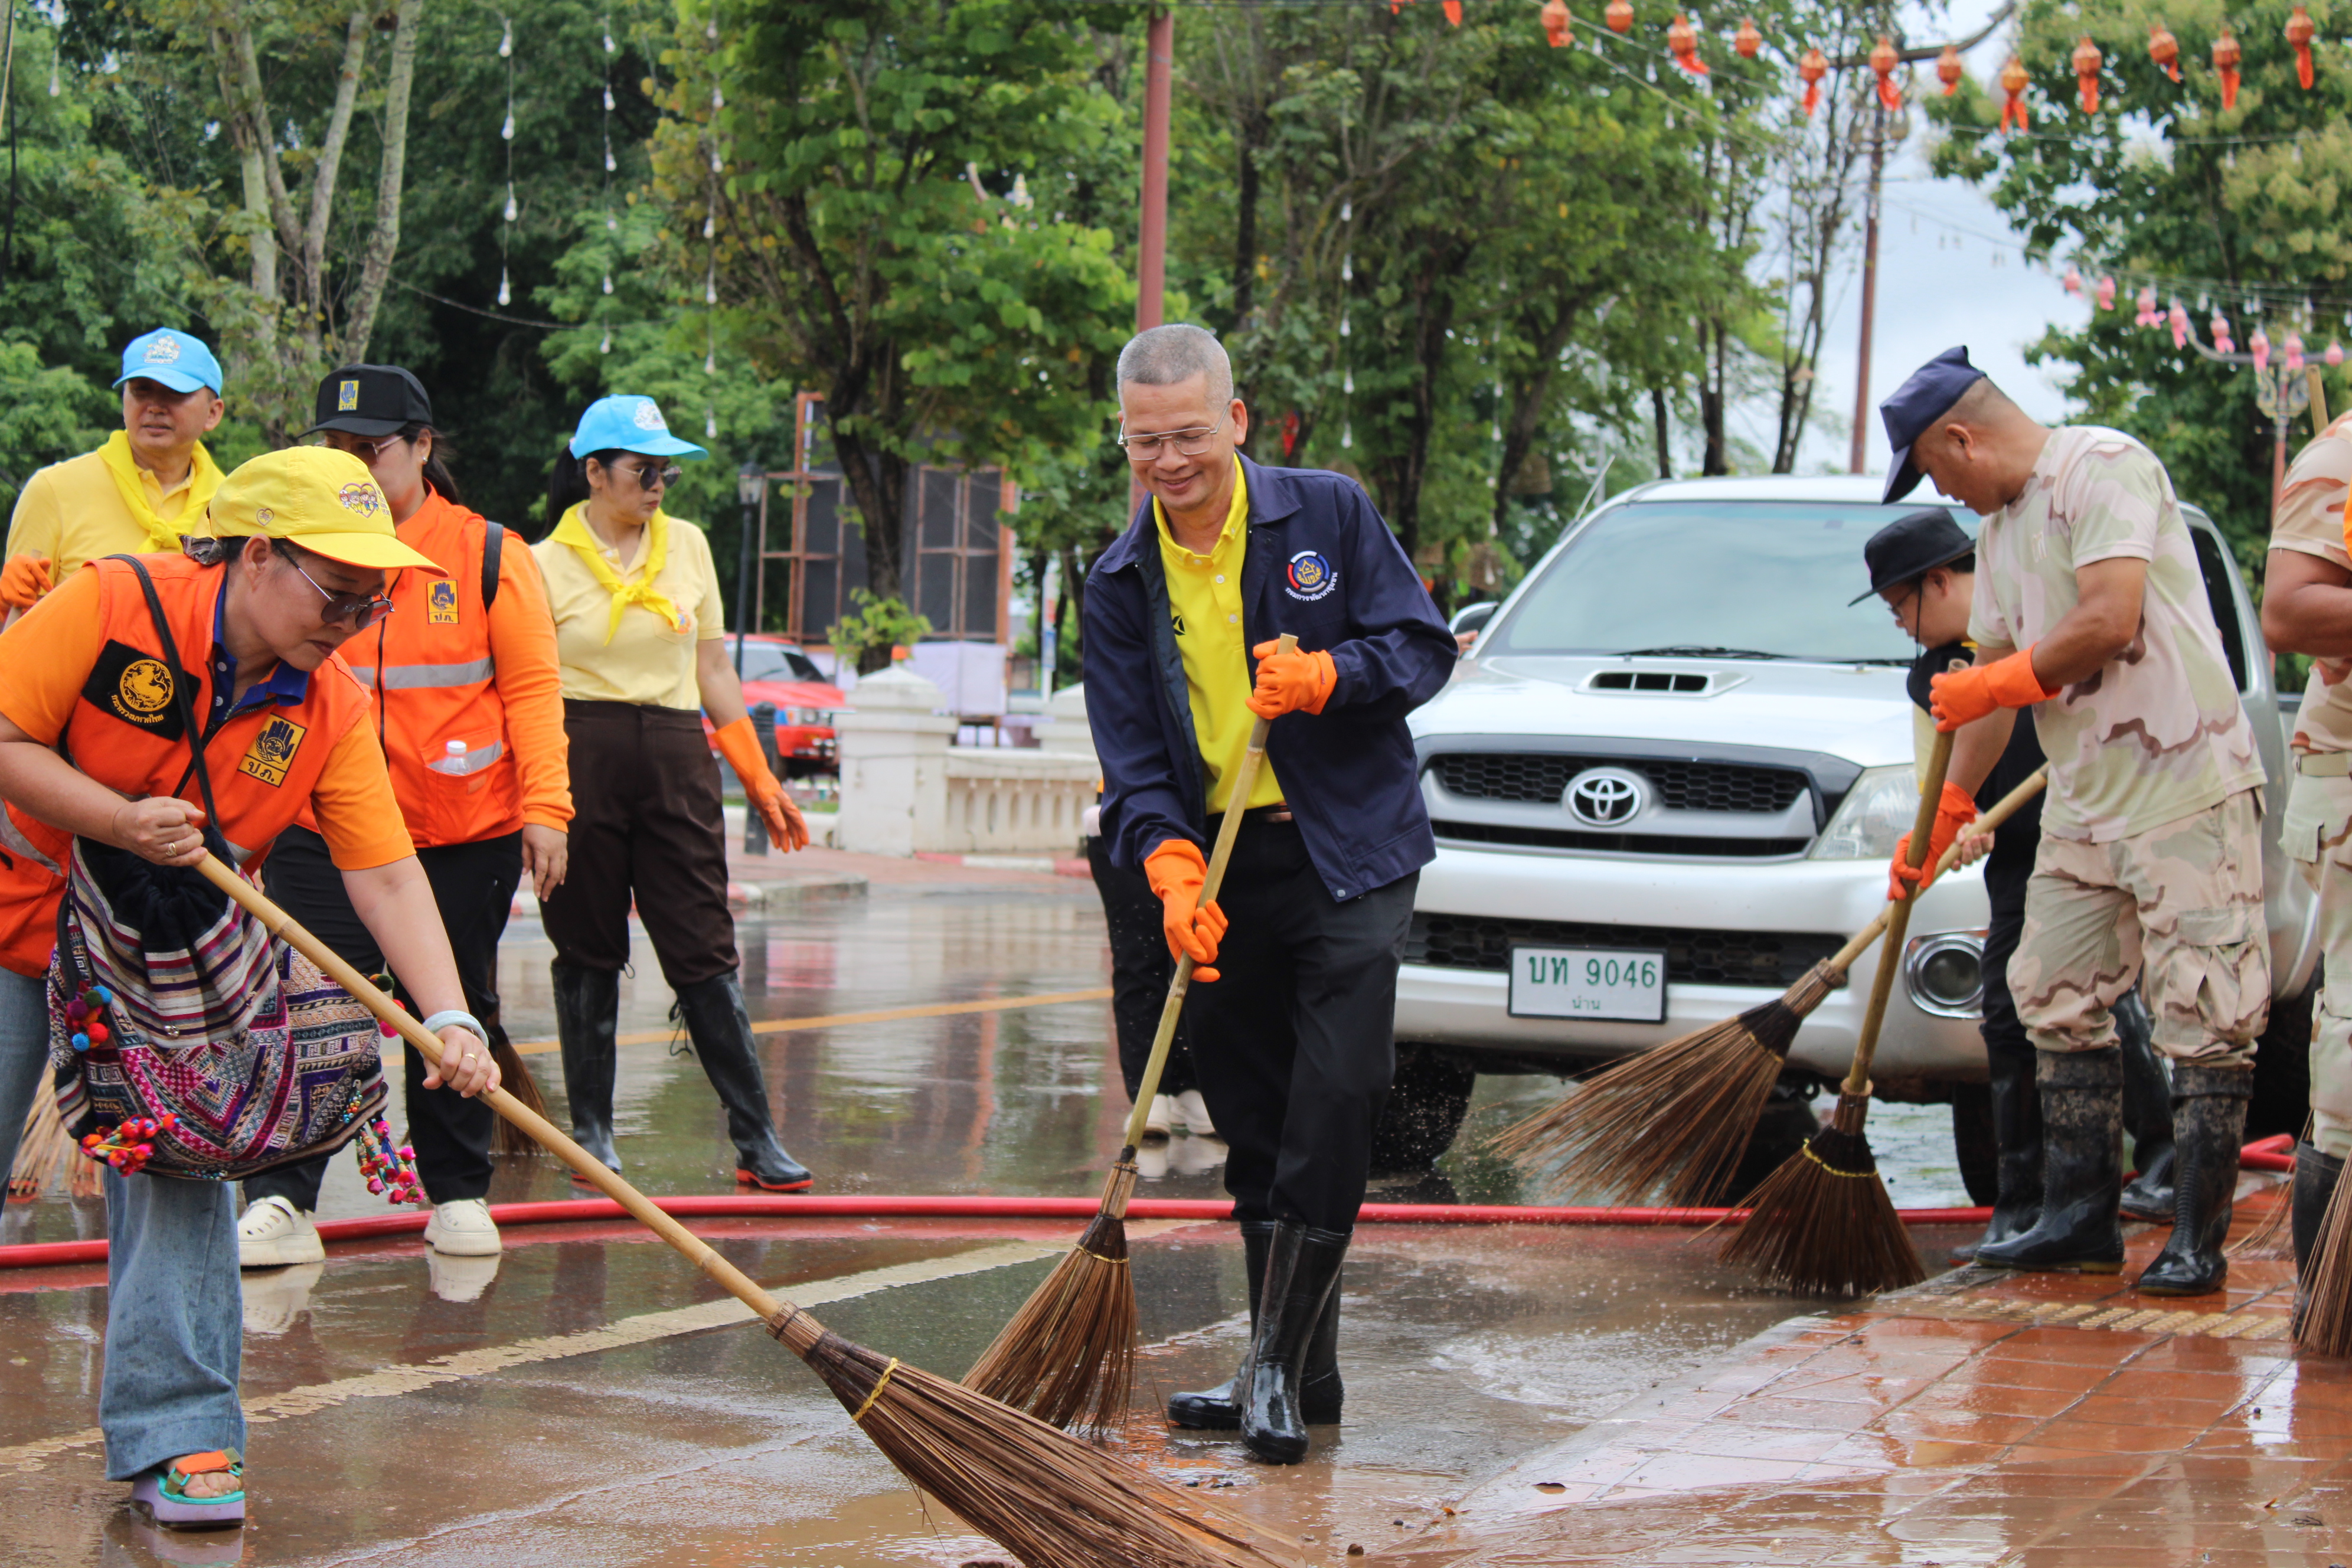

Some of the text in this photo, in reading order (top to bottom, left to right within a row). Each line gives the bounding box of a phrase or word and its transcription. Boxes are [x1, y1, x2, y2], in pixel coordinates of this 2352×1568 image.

[1285, 571, 1338, 601] กรมการพัฒนาชุมชน
[111, 694, 164, 723] กระทรวงมหาดไทย
[1528, 956, 1657, 989] บท 9046
[1572, 995, 1601, 1011] น่าน
